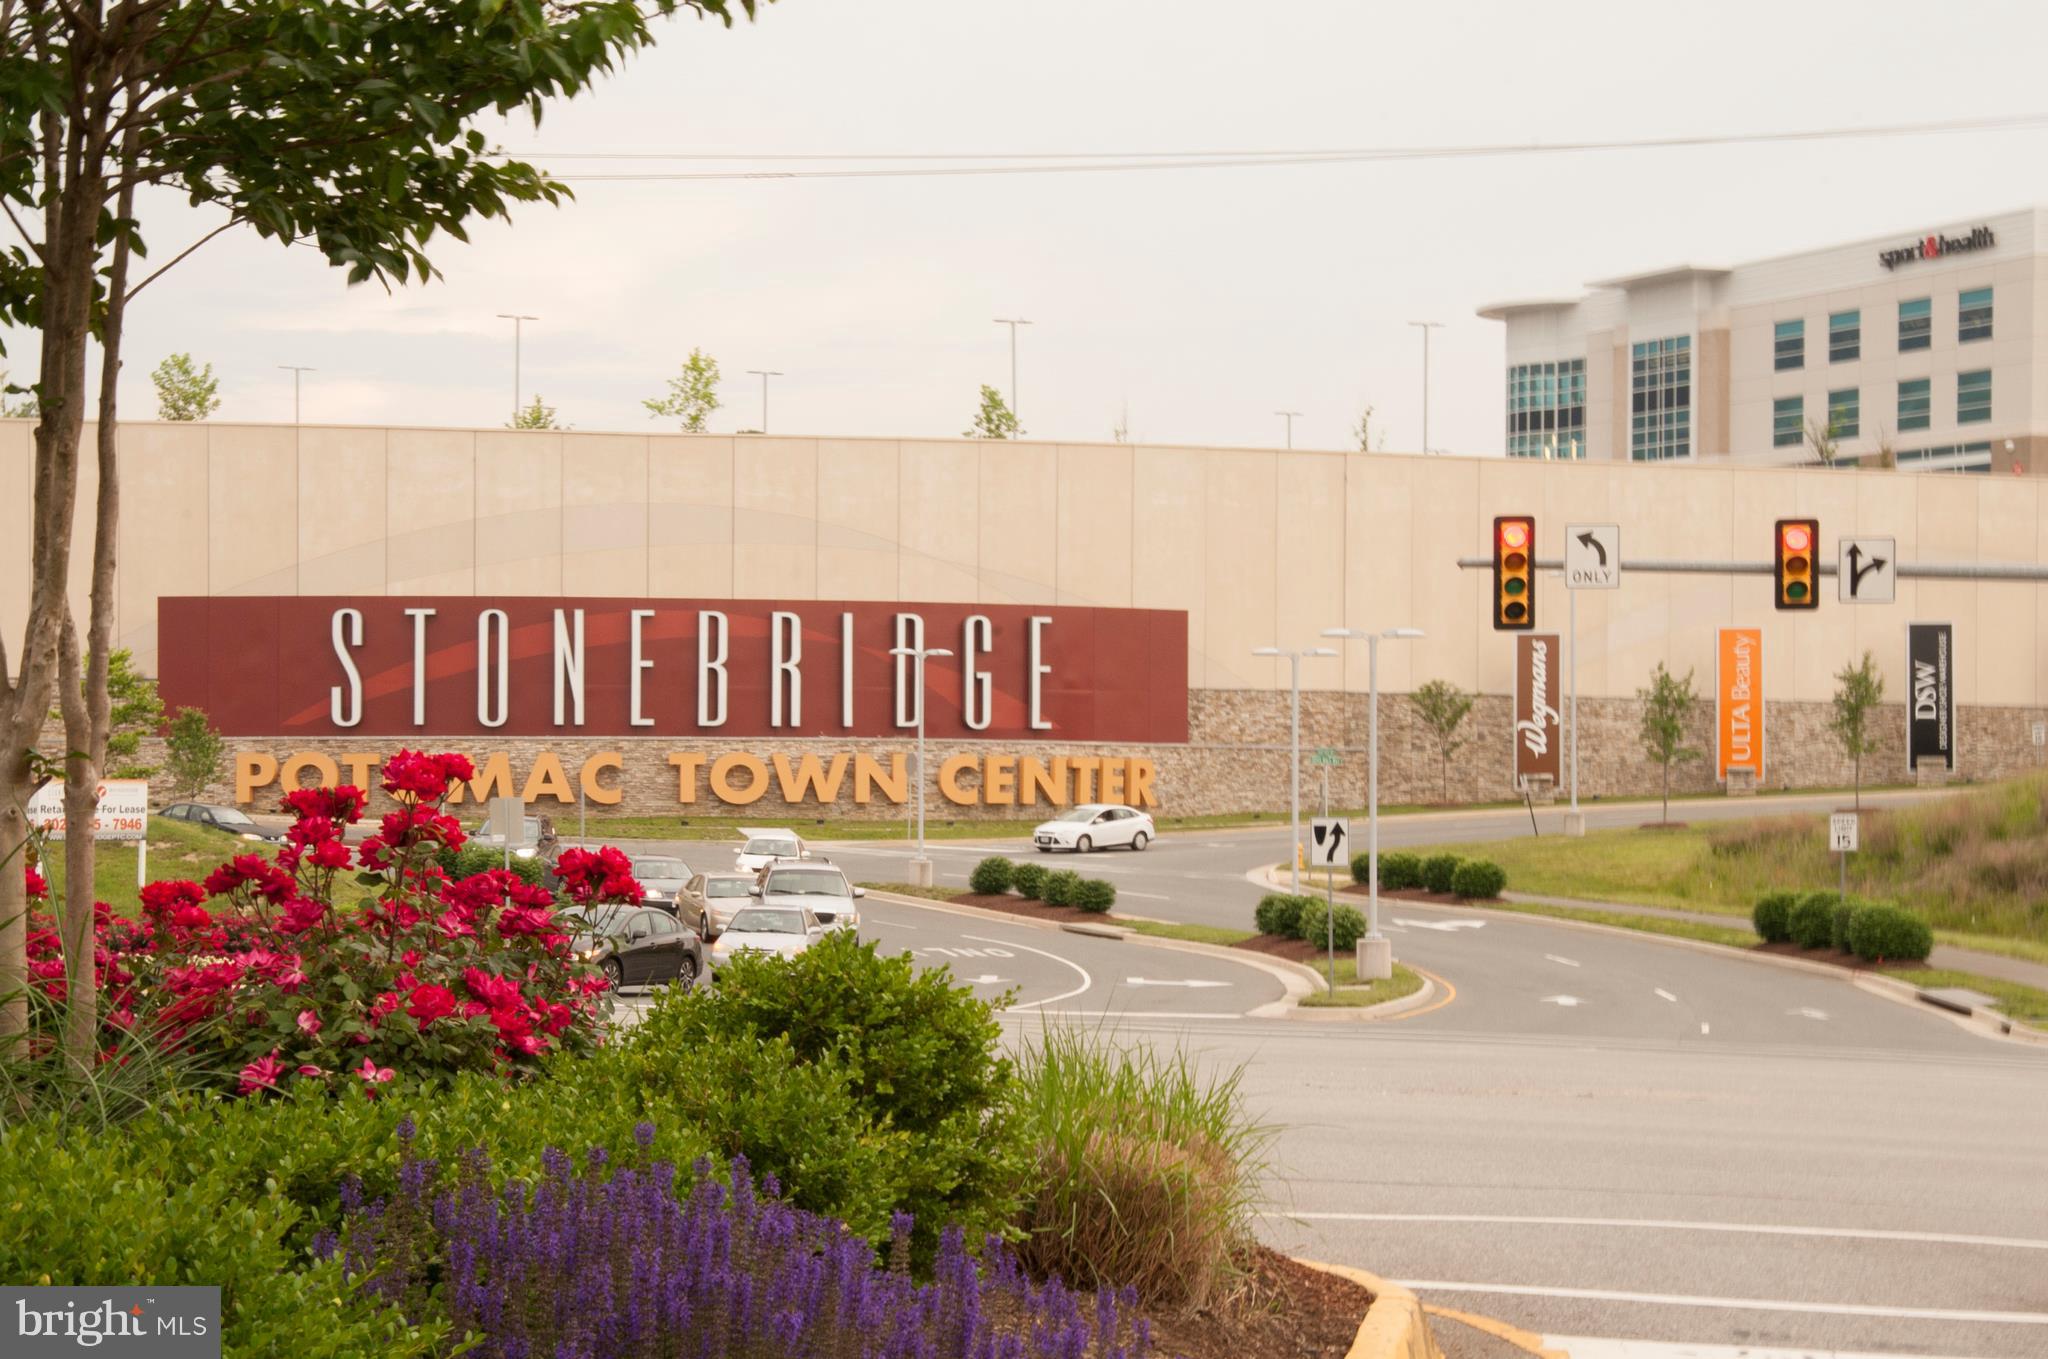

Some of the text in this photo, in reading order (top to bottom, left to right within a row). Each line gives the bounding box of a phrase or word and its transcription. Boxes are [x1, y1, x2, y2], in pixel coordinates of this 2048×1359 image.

[1880, 226, 1995, 271] sport&health
[1573, 570, 1611, 584] ONLY
[331, 607, 1053, 731] STONEBRIDGE
[1915, 659, 1936, 721] DSW
[1517, 638, 1560, 760] Wegmans
[1731, 633, 1757, 761] ULTA Beauty
[235, 751, 1159, 807] POTMAC TOWN CENTER
[102, 804, 116, 814] For
[119, 804, 146, 814] Lease
[112, 818, 142, 831] 7946
[1837, 835, 1851, 849] 15
